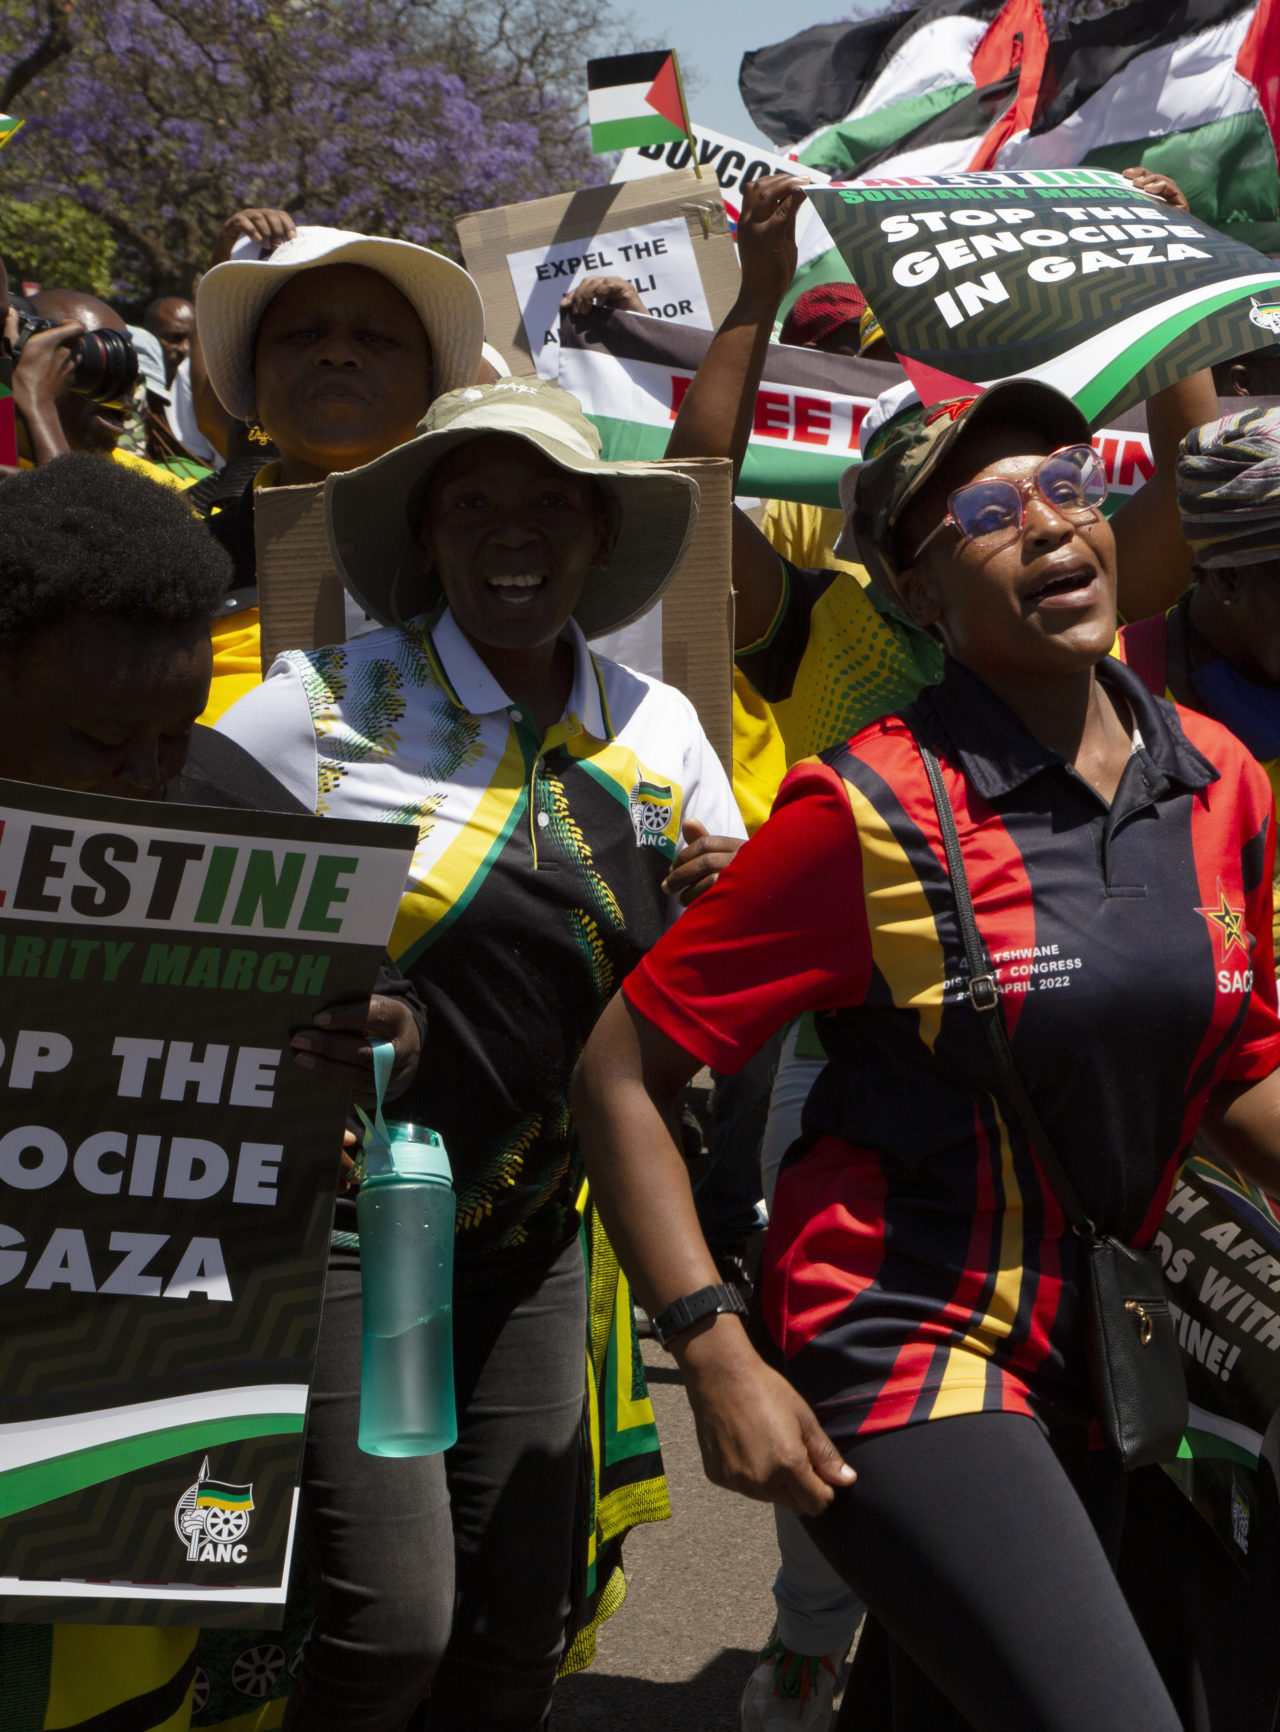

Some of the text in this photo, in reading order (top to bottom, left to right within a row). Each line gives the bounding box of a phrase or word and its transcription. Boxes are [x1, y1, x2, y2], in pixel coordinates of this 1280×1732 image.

[838, 187, 1025, 204] SOLIDARITY
[880, 206, 1169, 243] STOP THE
[535, 238, 668, 281] EXPEL THE
[891, 224, 1206, 289] GENOCIDE
[933, 243, 1213, 329] IN GAZA
[639, 834, 668, 847] ANC
[140, 941, 331, 997] MARCH
[993, 944, 1060, 964] TSHWANE
[1010, 957, 1083, 978] CONGRESS
[996, 975, 1071, 995] APRIL 2022
[1217, 969, 1253, 994] SAC
[111, 1036, 283, 1109] THE
[0, 1224, 234, 1303] AZA
[200, 1544, 249, 1565] ANC
